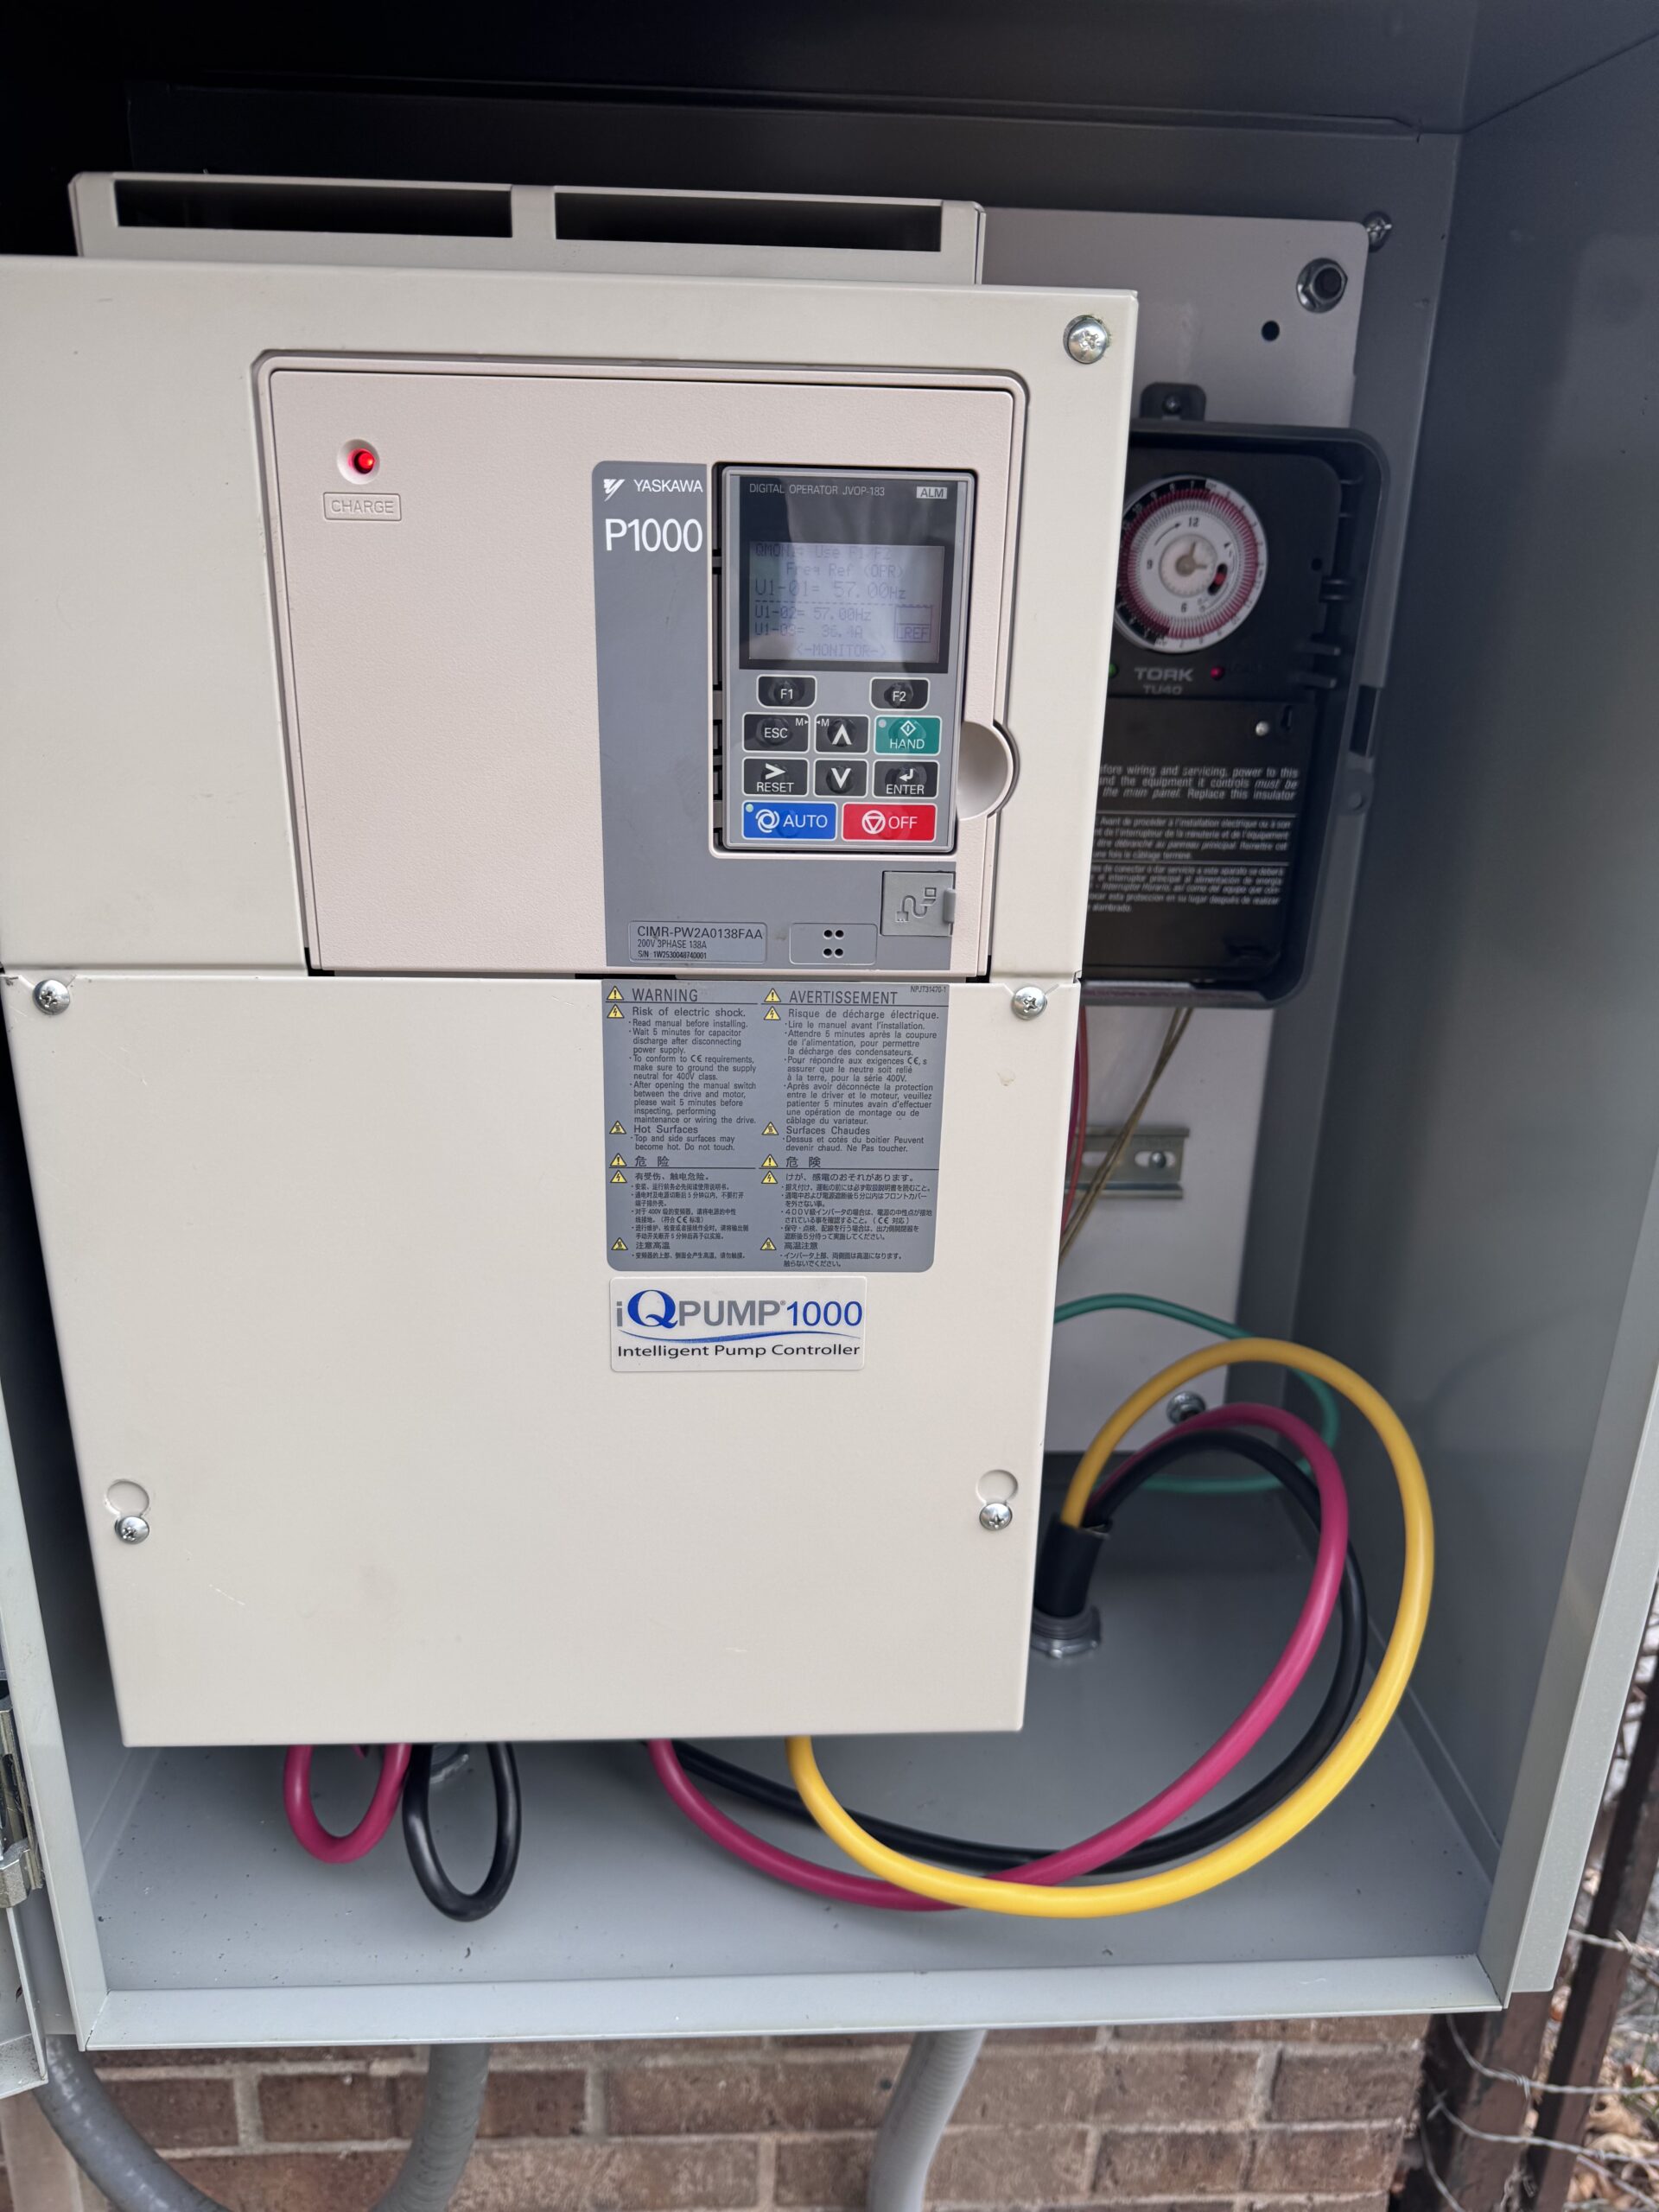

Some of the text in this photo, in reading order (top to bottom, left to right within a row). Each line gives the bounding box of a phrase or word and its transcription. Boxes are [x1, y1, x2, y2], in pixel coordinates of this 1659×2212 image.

[633, 479, 703, 493] YASKAWA
[750, 484, 885, 496] DIGITAL OPERATOR JVOP-183
[920, 488, 944, 498] ALM
[331, 500, 394, 513] CHARGE
[1188, 518, 1199, 527] 12
[606, 518, 702, 551] P1000
[1135, 667, 1194, 681] TORK
[781, 690, 793, 699] F1
[893, 691, 906, 702] F2
[765, 728, 787, 738] ESC
[890, 739, 925, 749] HAND
[757, 783, 794, 792] RESET
[887, 785, 925, 794] ENTER
[783, 815, 828, 828] AUTO
[888, 817, 918, 829] OFF
[638, 926, 762, 939] CIMR-PW2A0138FAA
[632, 988, 698, 1001] WARNING
[790, 991, 898, 1004] AVERTISSEMENT
[632, 1007, 652, 1015] Risk
[659, 1007, 669, 1016] of
[675, 1007, 709, 1016] electric
[789, 1009, 939, 1020] Risque de décharge électrique.
[714, 1020, 747, 1029] installing.
[709, 1029, 741, 1038] capacitor
[633, 1037, 667, 1046] discharge
[692, 1038, 741, 1046] disconnecting
[705, 1055, 754, 1065] requirements,
[688, 1065, 714, 1073] ground
[733, 1065, 756, 1073] supply
[656, 1082, 683, 1090] opening
[634, 1099, 657, 1108] please
[634, 1108, 716, 1116] inspecting, performing
[696, 1116, 716, 1125] wiring
[657, 1125, 698, 1134] Surfaces
[634, 1135, 647, 1143] Top
[720, 1135, 734, 1144] may
[618, 1344, 860, 1358] Intelligent Pump Controller
